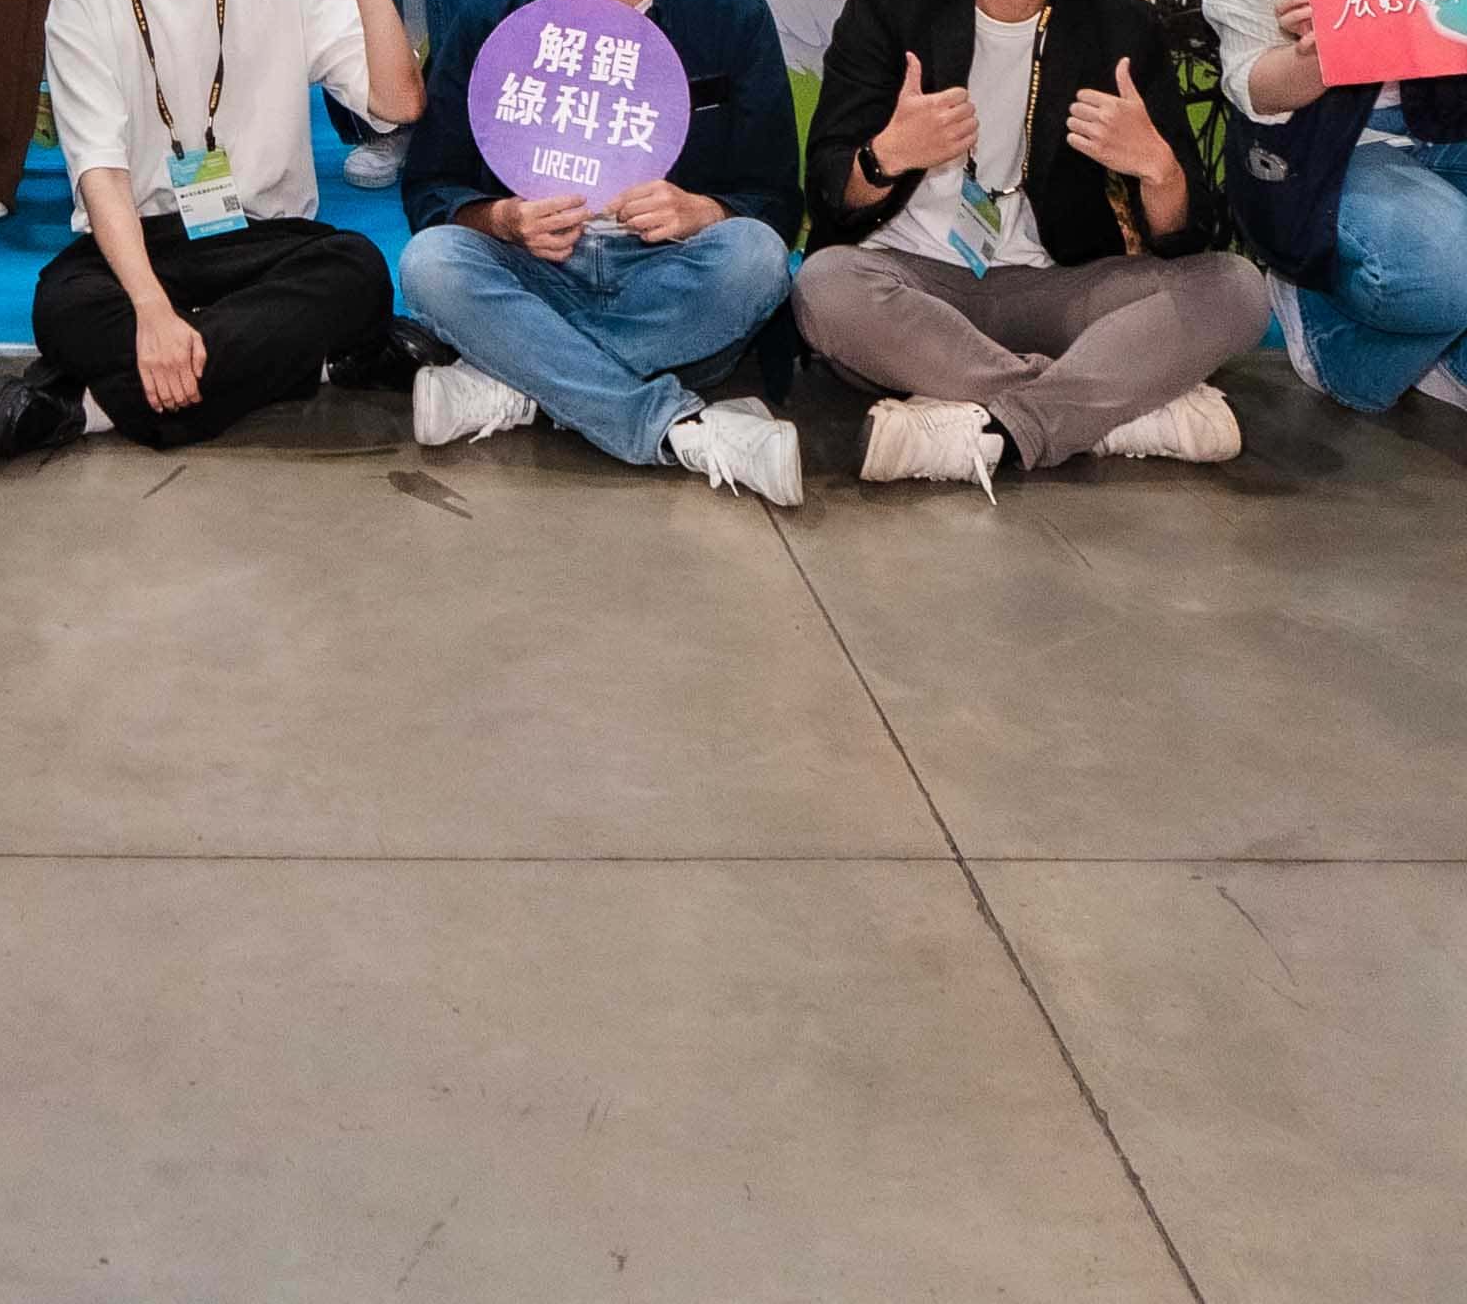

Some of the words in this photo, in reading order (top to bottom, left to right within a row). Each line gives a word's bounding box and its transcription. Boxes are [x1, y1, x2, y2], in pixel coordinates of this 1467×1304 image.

[533, 22, 641, 90] 解鎖
[495, 72, 659, 153] 綠科技
[532, 146, 601, 186] URECO
